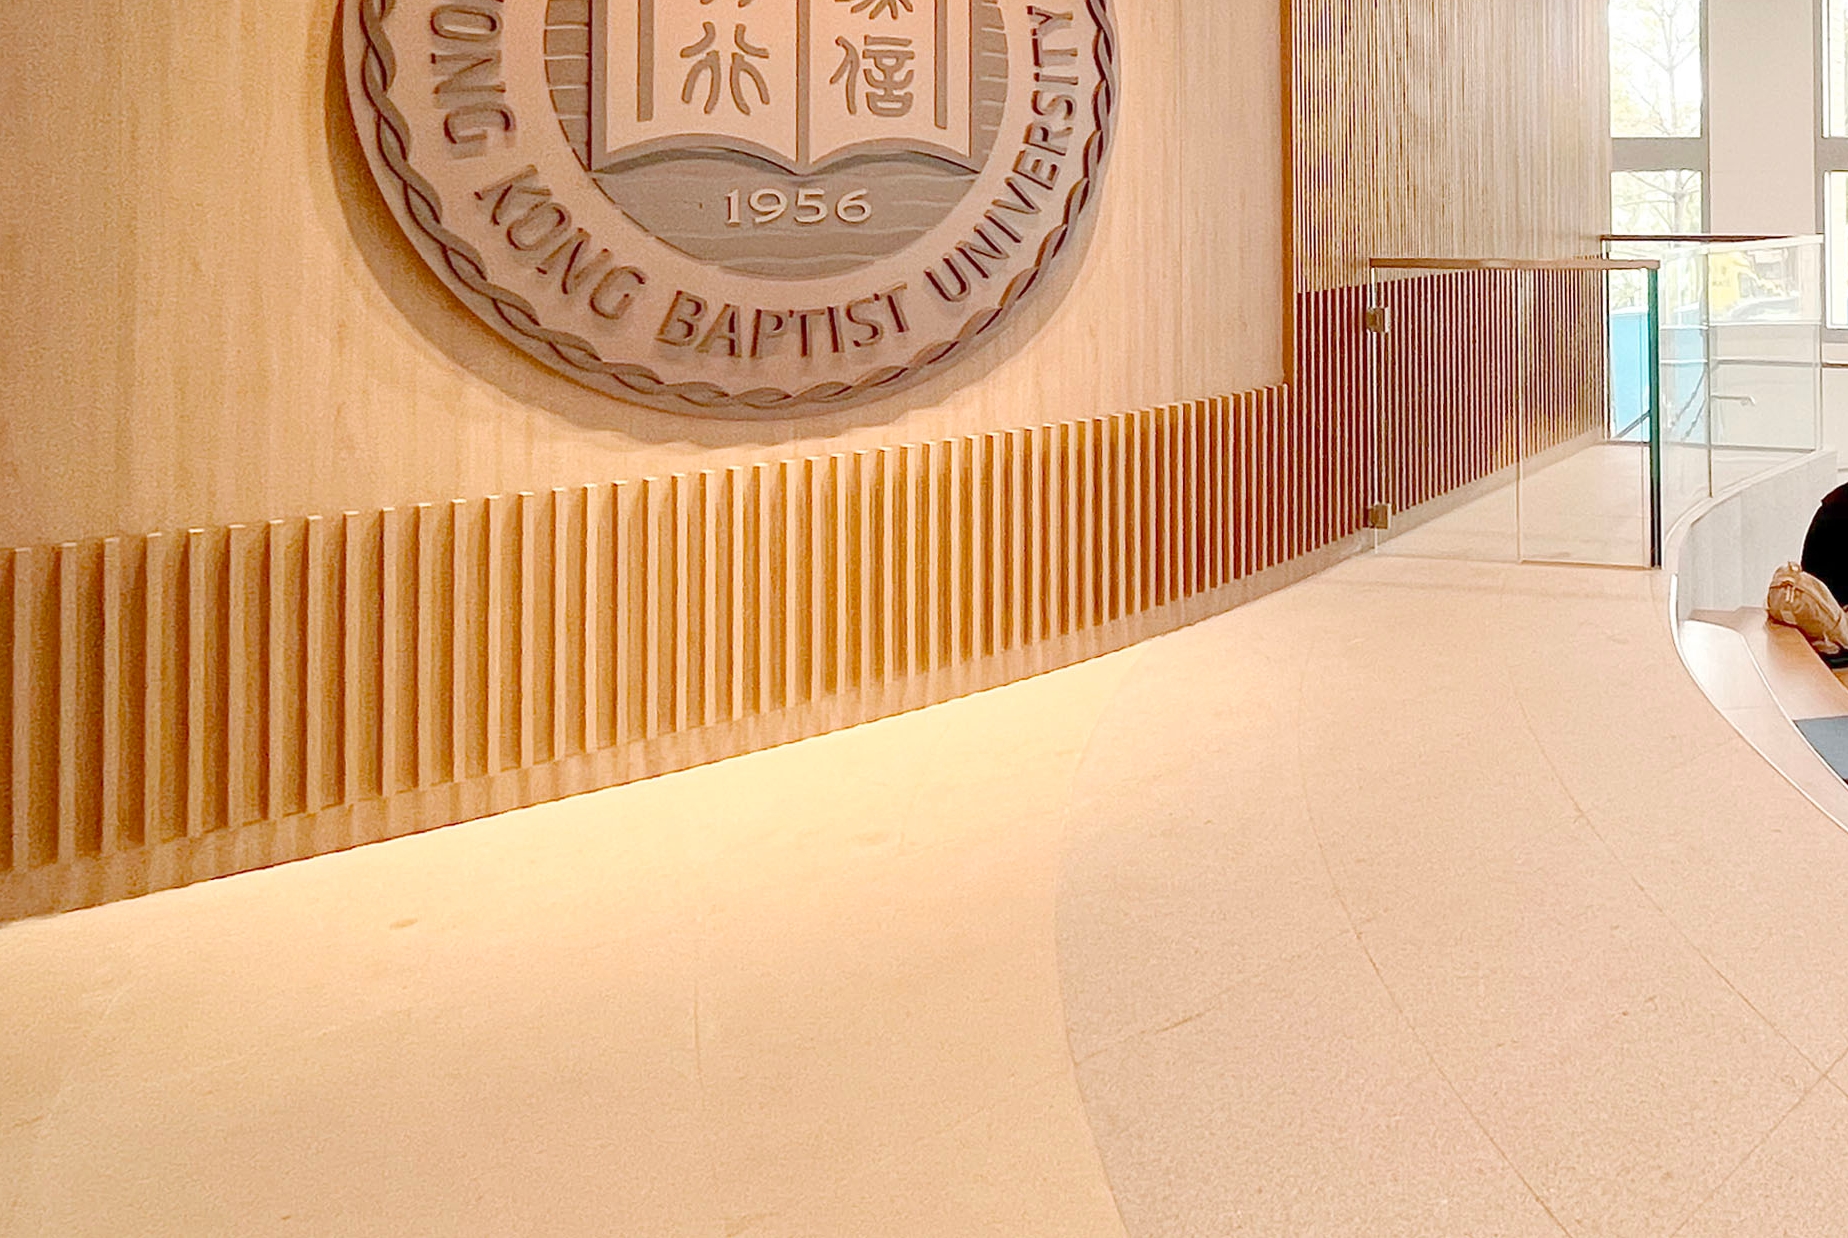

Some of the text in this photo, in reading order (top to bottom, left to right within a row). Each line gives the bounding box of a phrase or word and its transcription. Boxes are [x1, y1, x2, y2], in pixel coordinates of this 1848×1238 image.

[474, 164, 648, 322] KONG
[654, 281, 909, 362] BAPTIST
[924, 4, 1080, 304] UNIVERSITY
[725, 187, 873, 226] 1956
